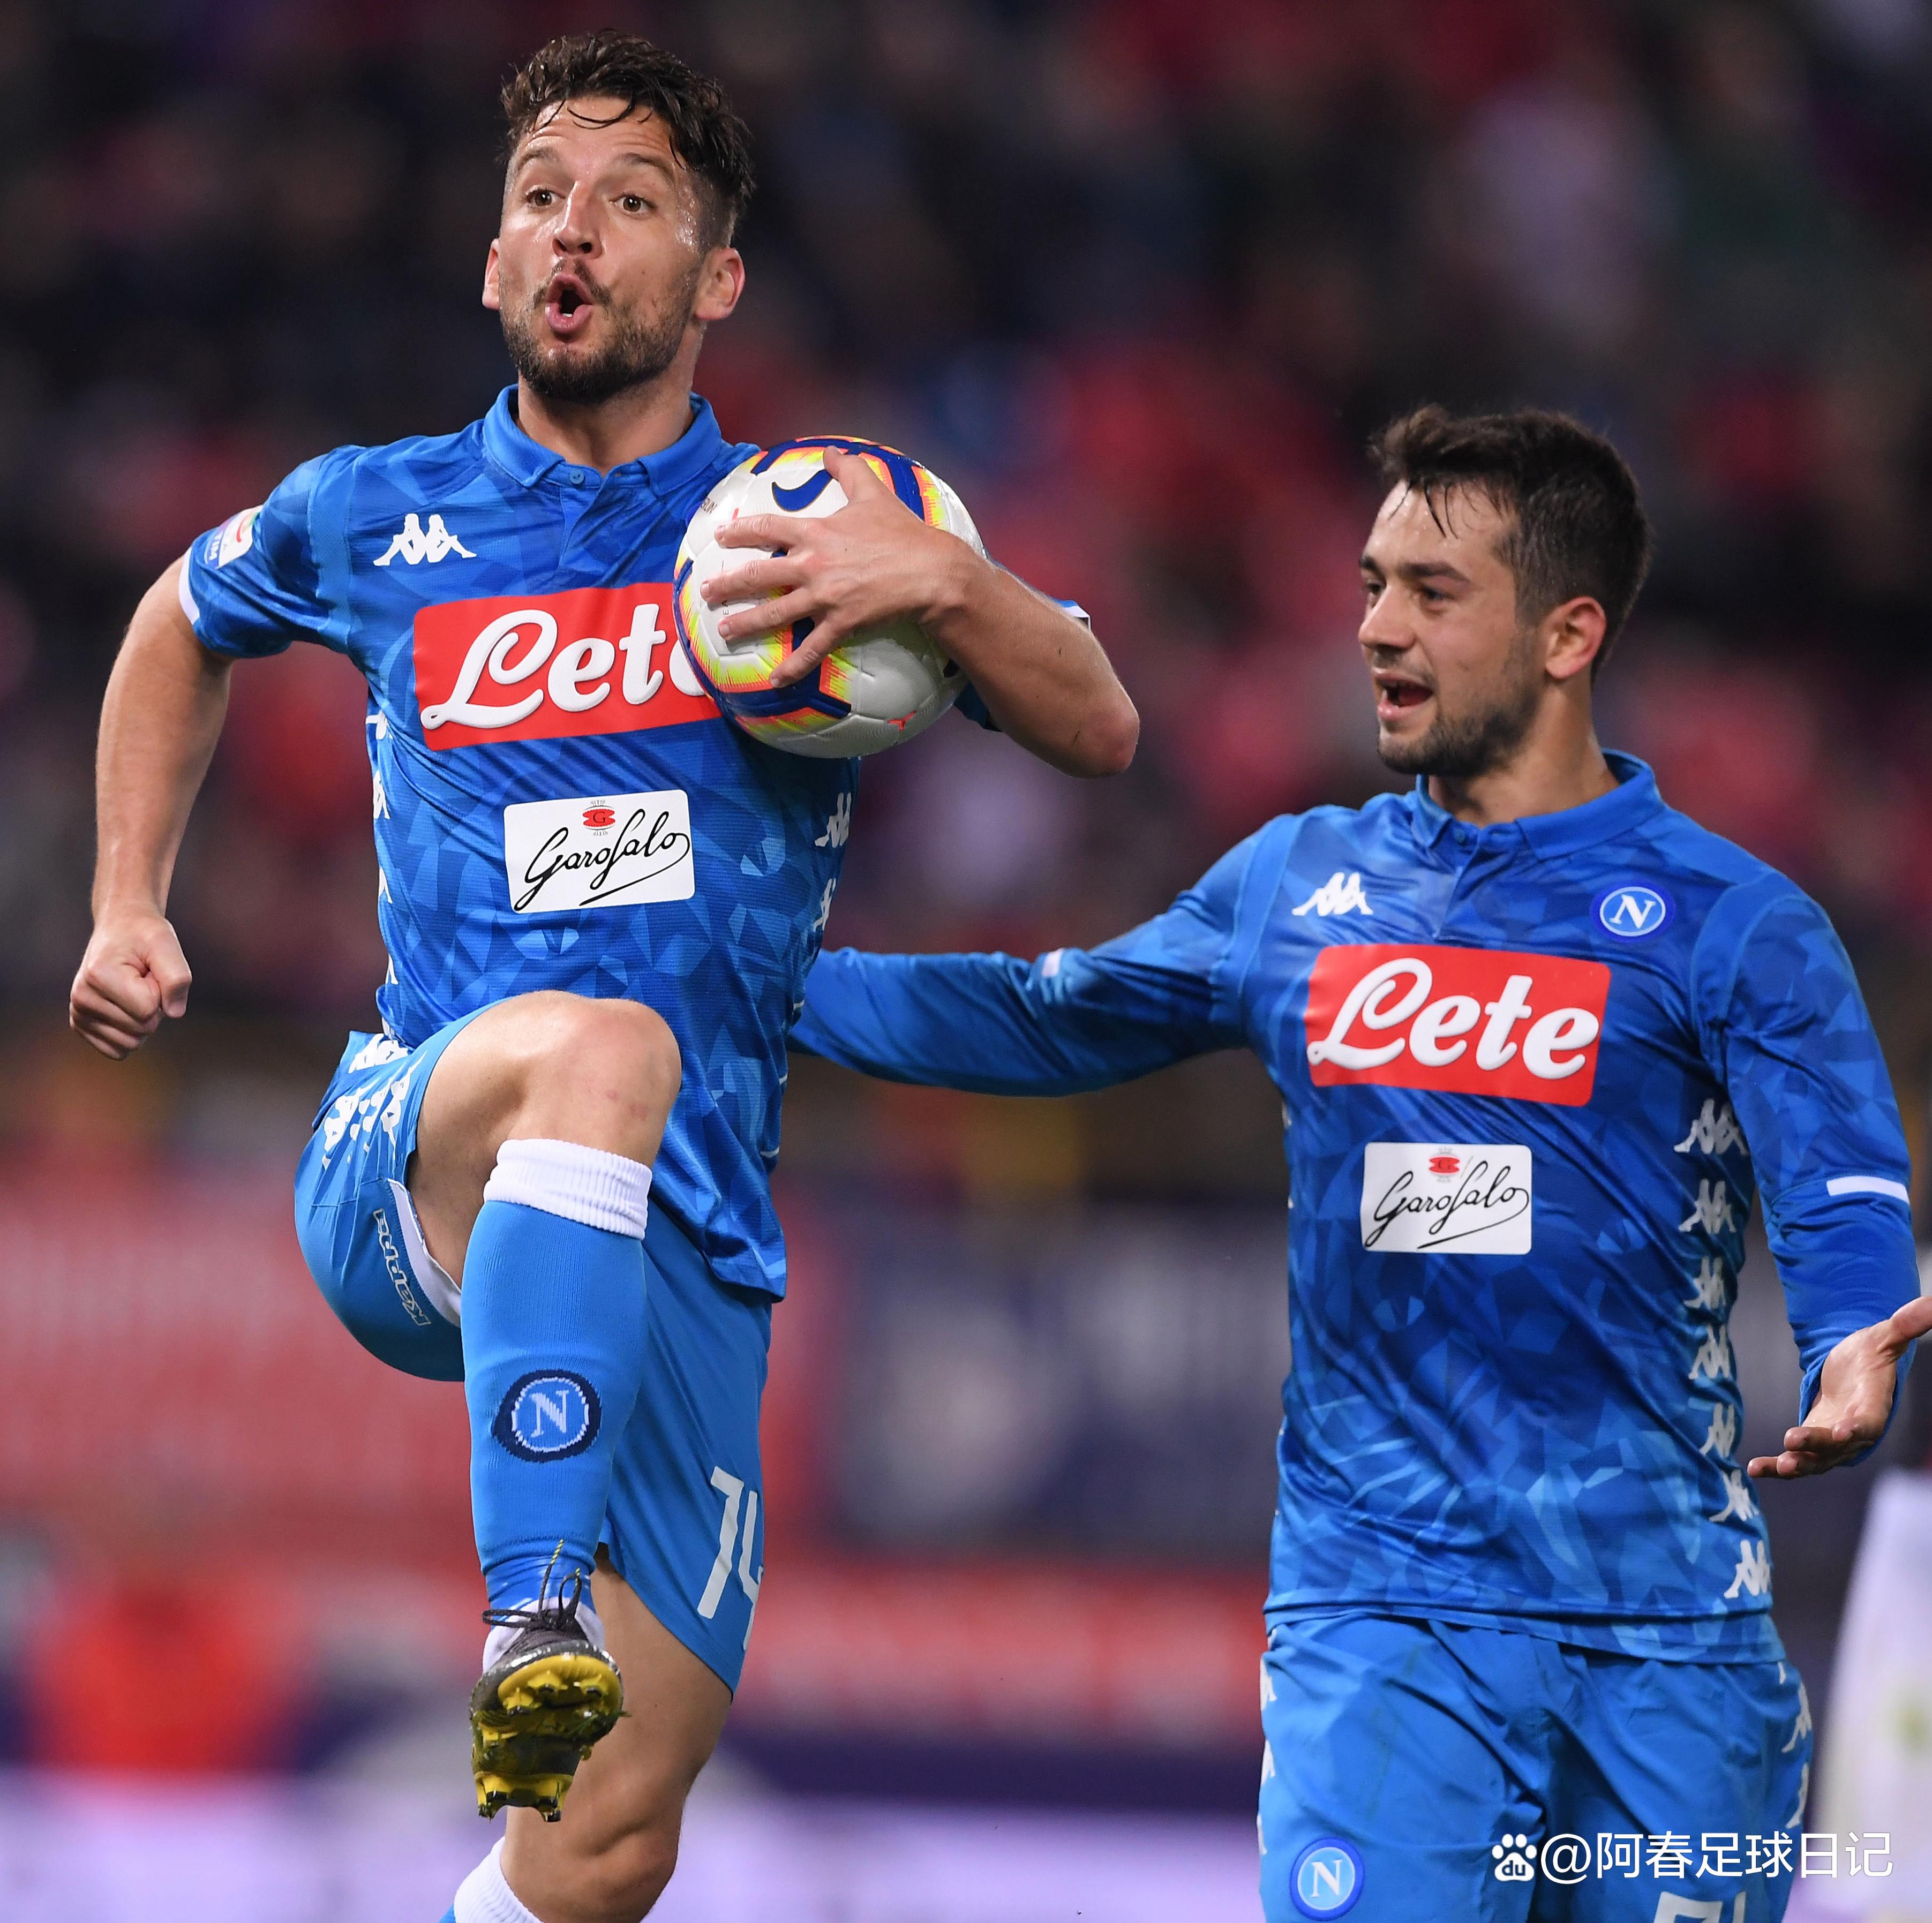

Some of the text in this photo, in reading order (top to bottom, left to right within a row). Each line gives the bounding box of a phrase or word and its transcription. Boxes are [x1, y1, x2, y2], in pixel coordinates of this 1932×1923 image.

[593, 811, 606, 824] G
[514, 809, 690, 911] Garofalo
[1609, 894, 1656, 929] N
[1307, 957, 1599, 1080] Lete
[1365, 1160, 1529, 1249] Garofalo
[373, 1208, 431, 1325] Kappa
[530, 1390, 569, 1438] N
[1310, 1859, 1343, 1898] N
